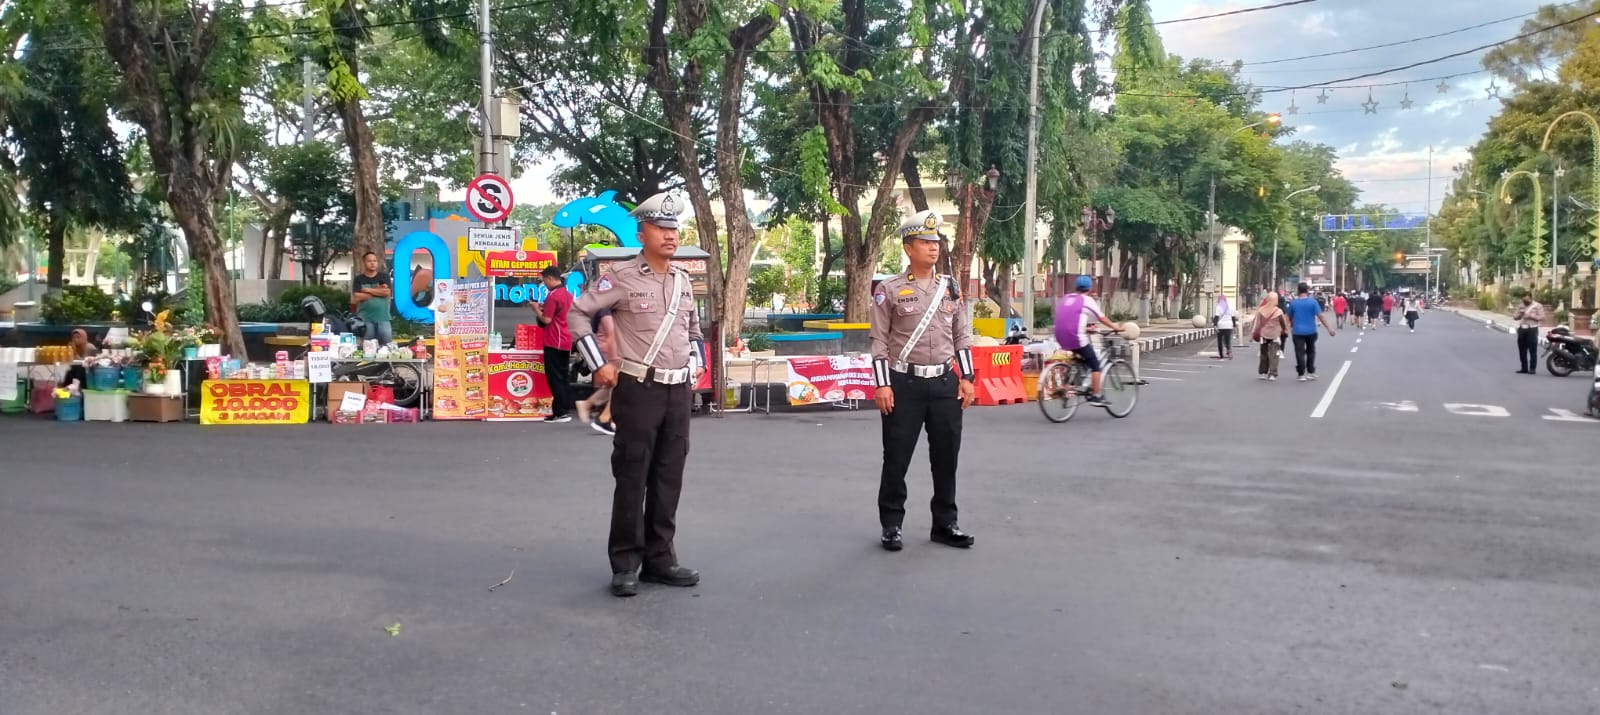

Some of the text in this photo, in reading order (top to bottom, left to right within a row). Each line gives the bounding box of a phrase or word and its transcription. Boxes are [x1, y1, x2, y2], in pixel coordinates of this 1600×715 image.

[477, 184, 502, 213] S
[491, 259, 510, 270] AYAM
[511, 260, 538, 270] GEPREK
[897, 296, 919, 304] ENDRO
[489, 361, 508, 374] Kami
[511, 360, 530, 370] Hadir
[210, 383, 301, 397] OBRAL
[212, 397, 298, 411] 10.000
[219, 412, 229, 420] 3
